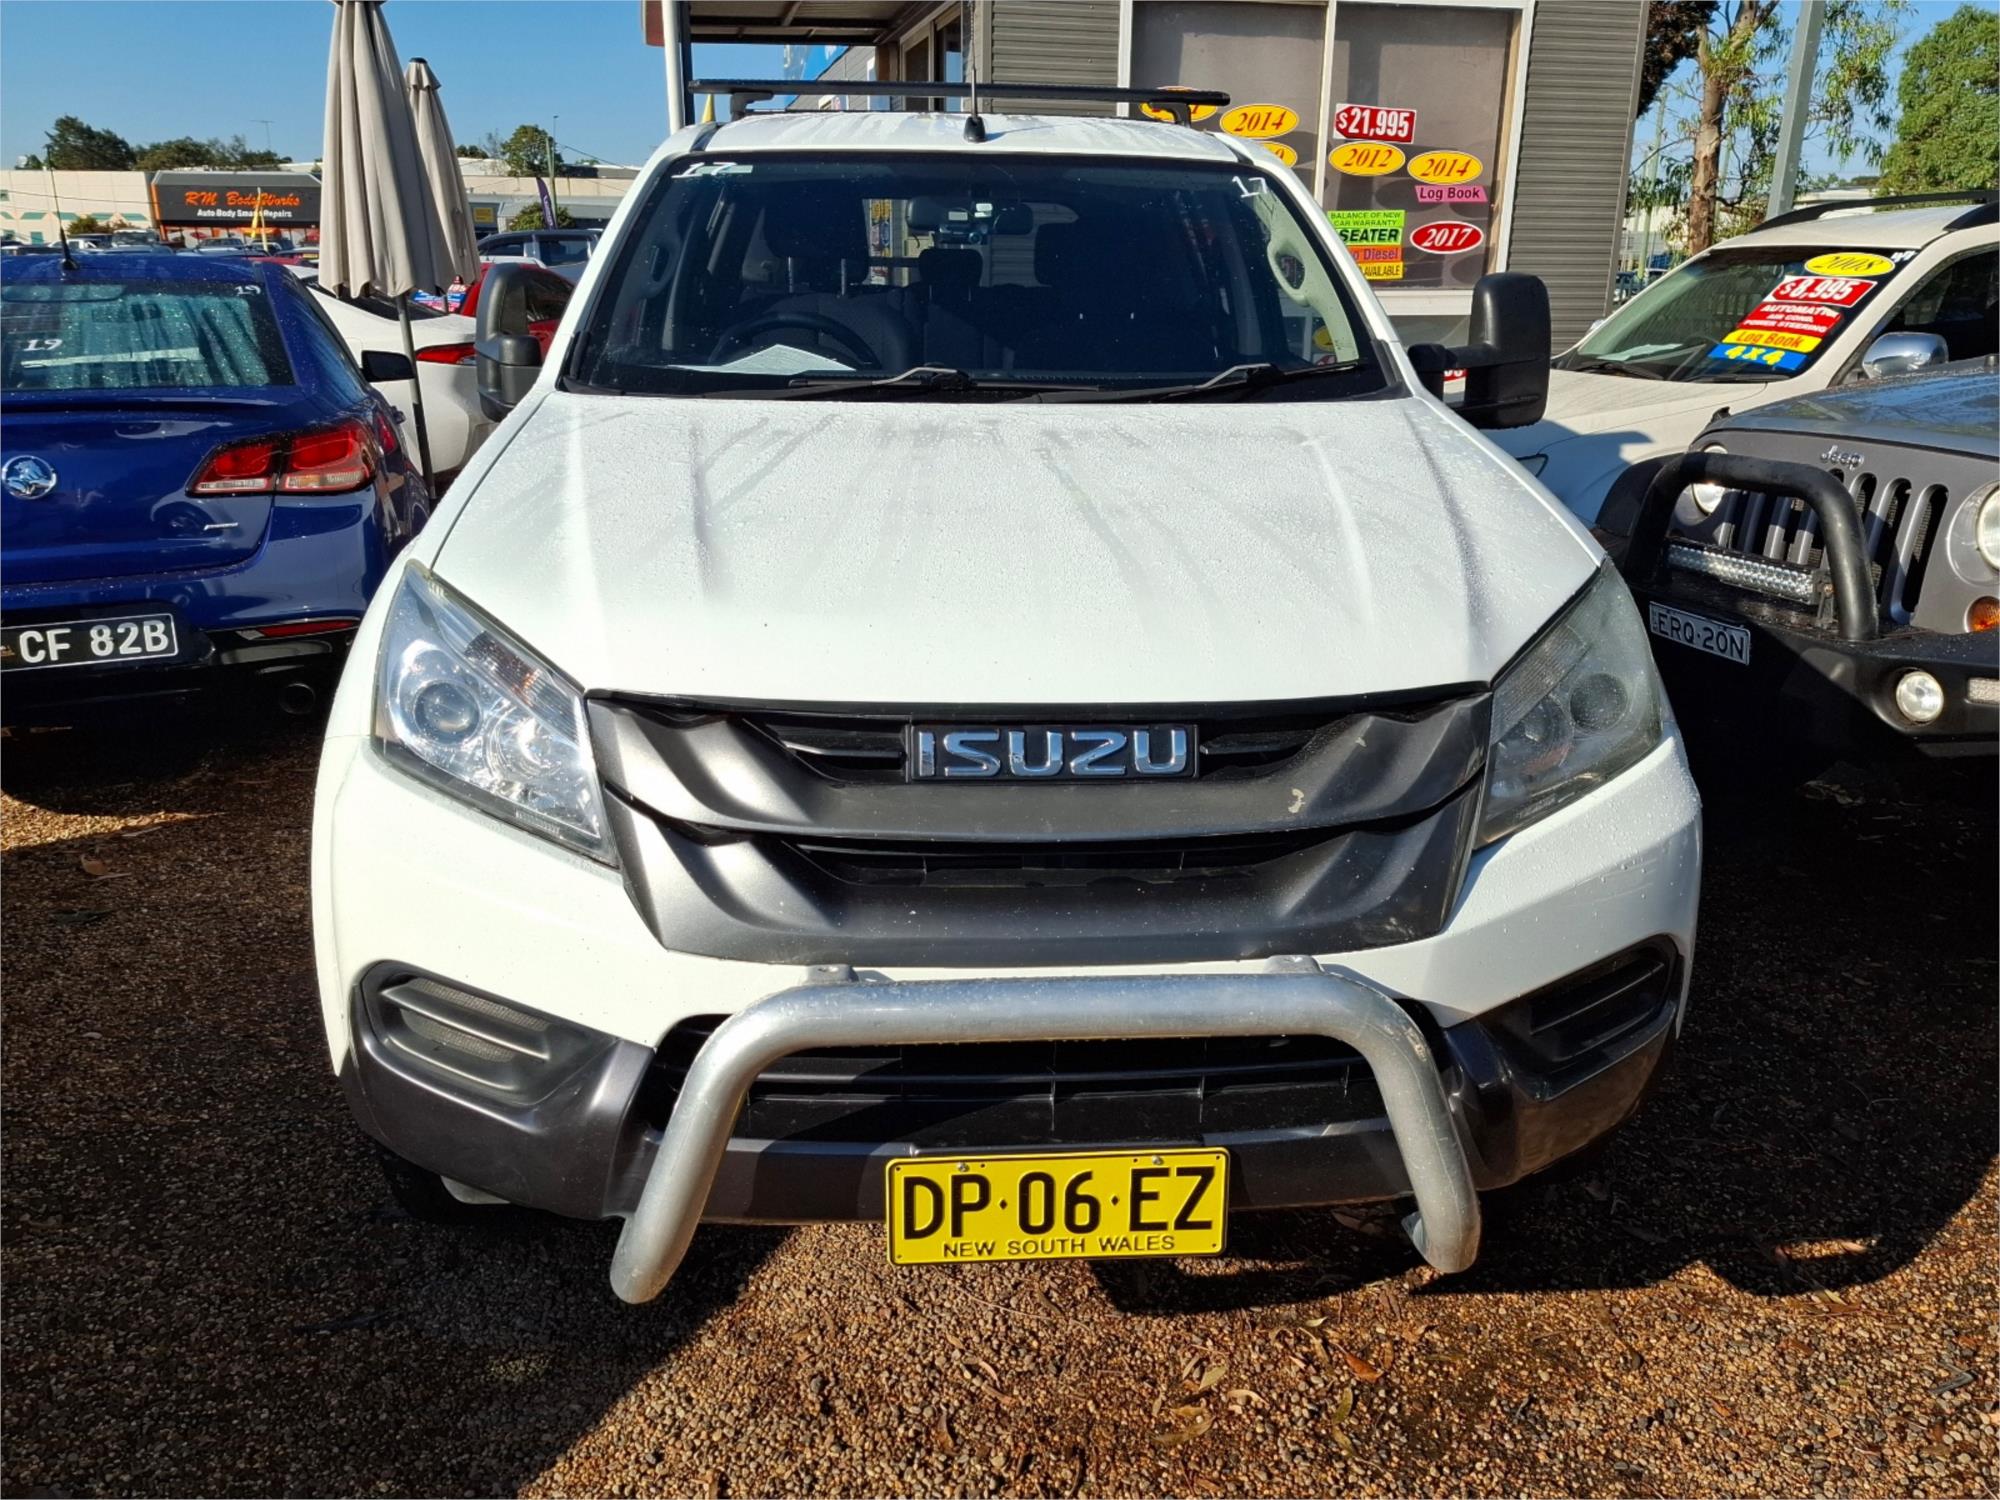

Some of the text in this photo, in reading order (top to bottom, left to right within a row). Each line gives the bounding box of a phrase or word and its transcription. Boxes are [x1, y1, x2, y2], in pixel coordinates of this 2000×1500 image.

[1233, 110, 1287, 132] 2014
[1338, 107, 1410, 137] $21,995
[1343, 148, 1393, 168] 2012
[1420, 158, 1472, 177] 2014
[1232, 176, 1268, 198] 17
[1420, 187, 1480, 200] Log Book
[185, 191, 218, 206] RM
[197, 208, 292, 219] Auto Body Sma Repairs
[1339, 228, 1399, 242] SEATER
[1421, 228, 1473, 247] 2017
[1364, 248, 1398, 260] Diesel
[1812, 256, 1884, 271] 2008
[1364, 265, 1400, 276] AVAILABLE
[1780, 279, 1860, 300] $8,995
[1743, 319, 1828, 334] POWER STEERING
[23, 338, 63, 351] 19
[1736, 331, 1804, 348] Log Book
[1820, 444, 1865, 471] Jeep
[19, 619, 170, 664] CF 82B
[918, 730, 1188, 777] ISUZU
[943, 1235, 1176, 1257] NEW SOUTH WALES
